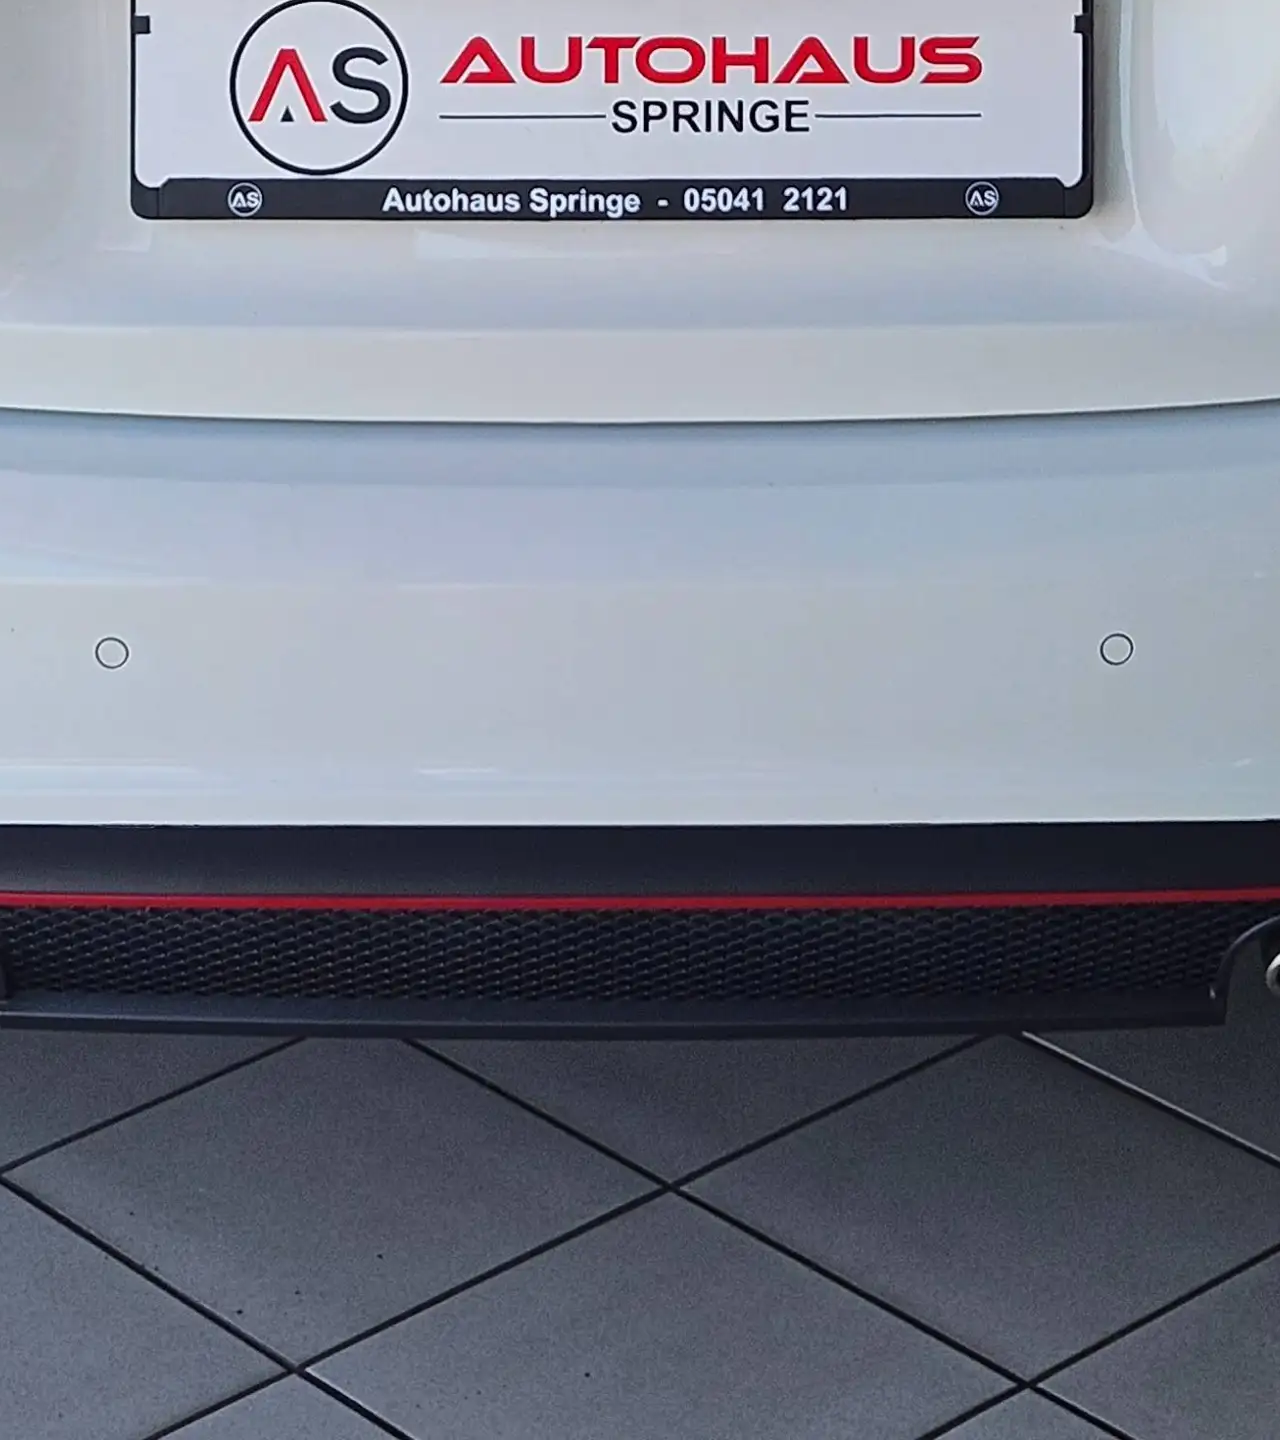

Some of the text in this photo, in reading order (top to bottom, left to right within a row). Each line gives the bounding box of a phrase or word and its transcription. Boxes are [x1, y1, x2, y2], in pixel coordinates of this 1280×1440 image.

[439, 35, 983, 84] AUTOHAUS
[247, 46, 392, 124] AS
[612, 99, 811, 133] SPRINGE
[382, 187, 521, 212] Autohaus
[529, 187, 641, 218] Springe
[683, 187, 765, 212] 05041
[782, 187, 848, 211] 2121
